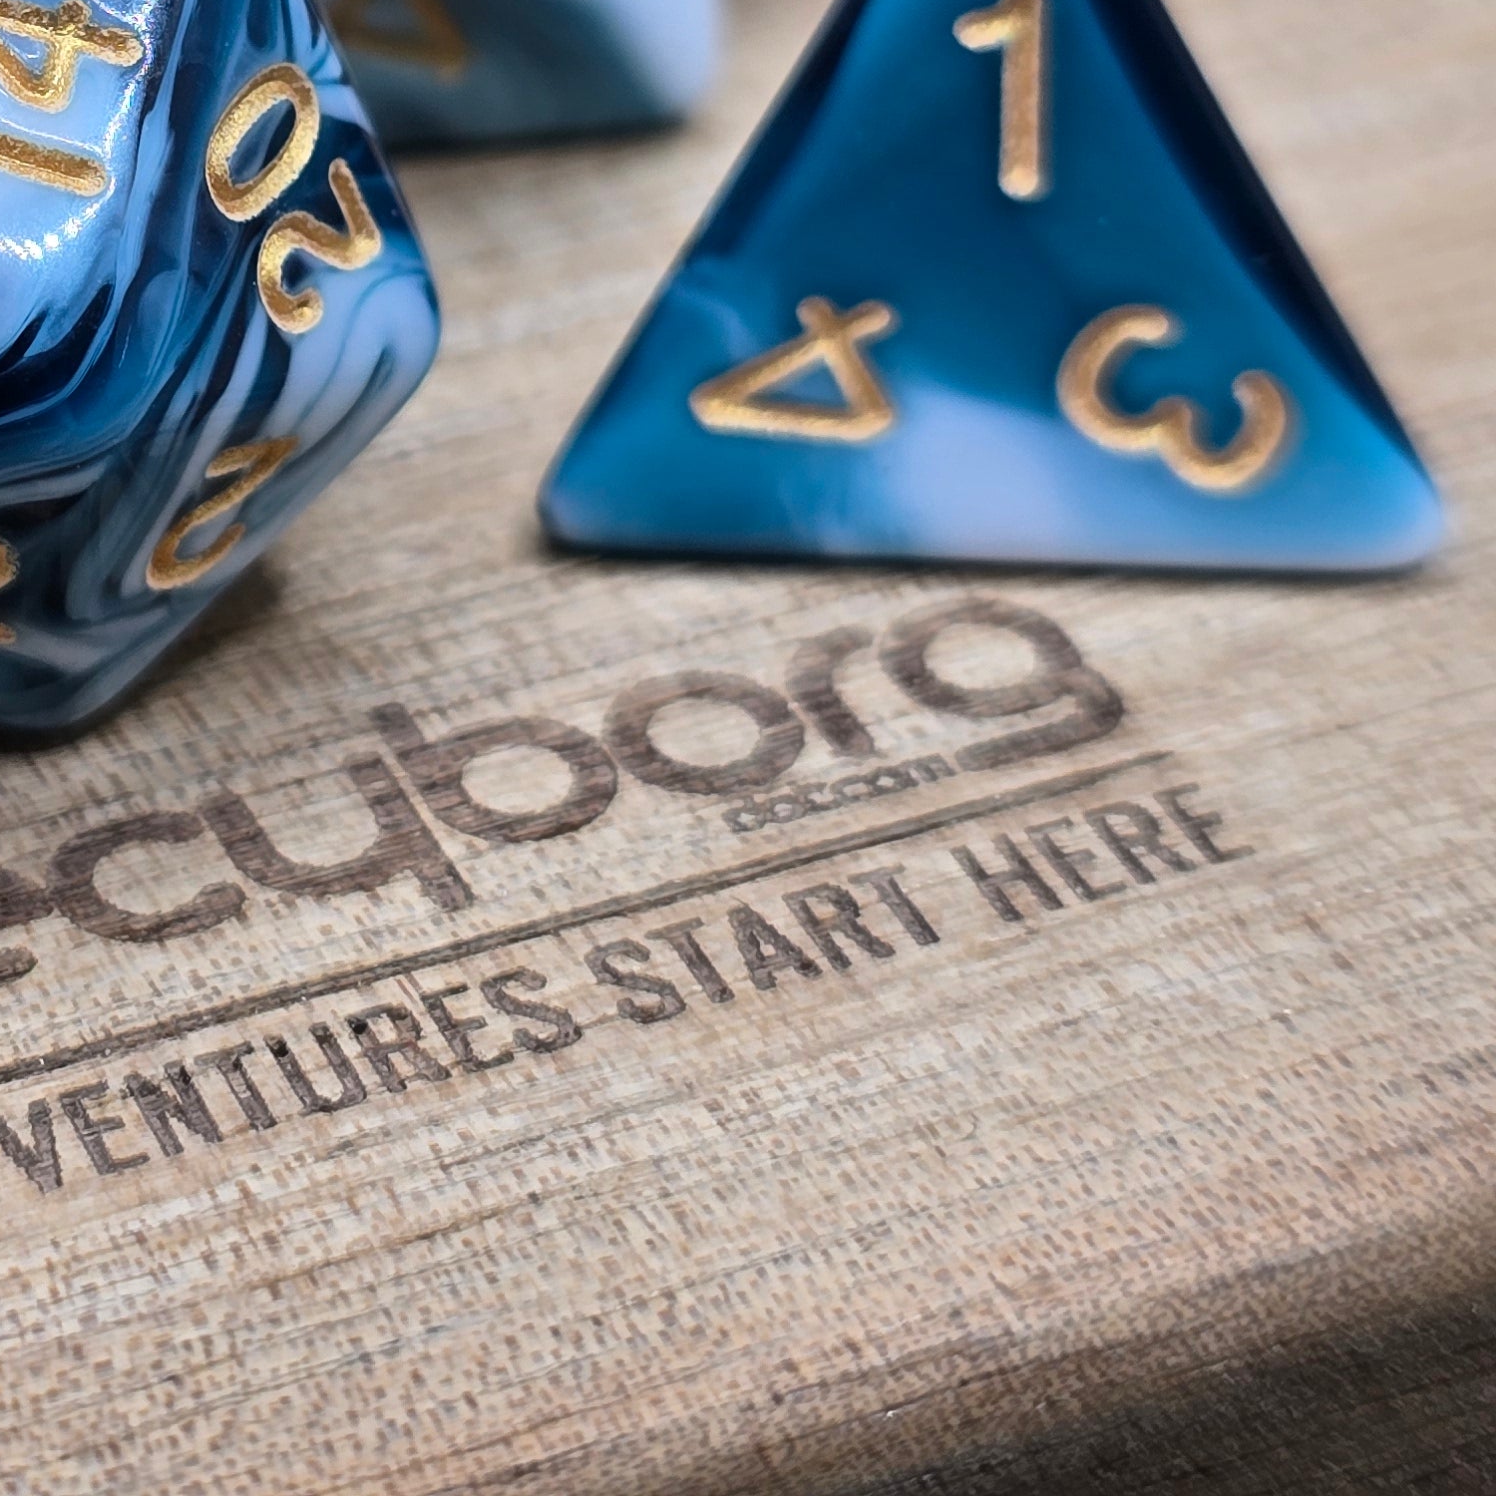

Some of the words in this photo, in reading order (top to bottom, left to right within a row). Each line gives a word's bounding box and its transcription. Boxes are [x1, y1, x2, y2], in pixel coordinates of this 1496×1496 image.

[206, 62, 382, 336] 20
[689, 297, 896, 444] 4
[1056, 304, 1291, 492] 3
[146, 436, 299, 592] 2
[584, 864, 942, 1025] START
[950, 782, 1254, 924] HERE
